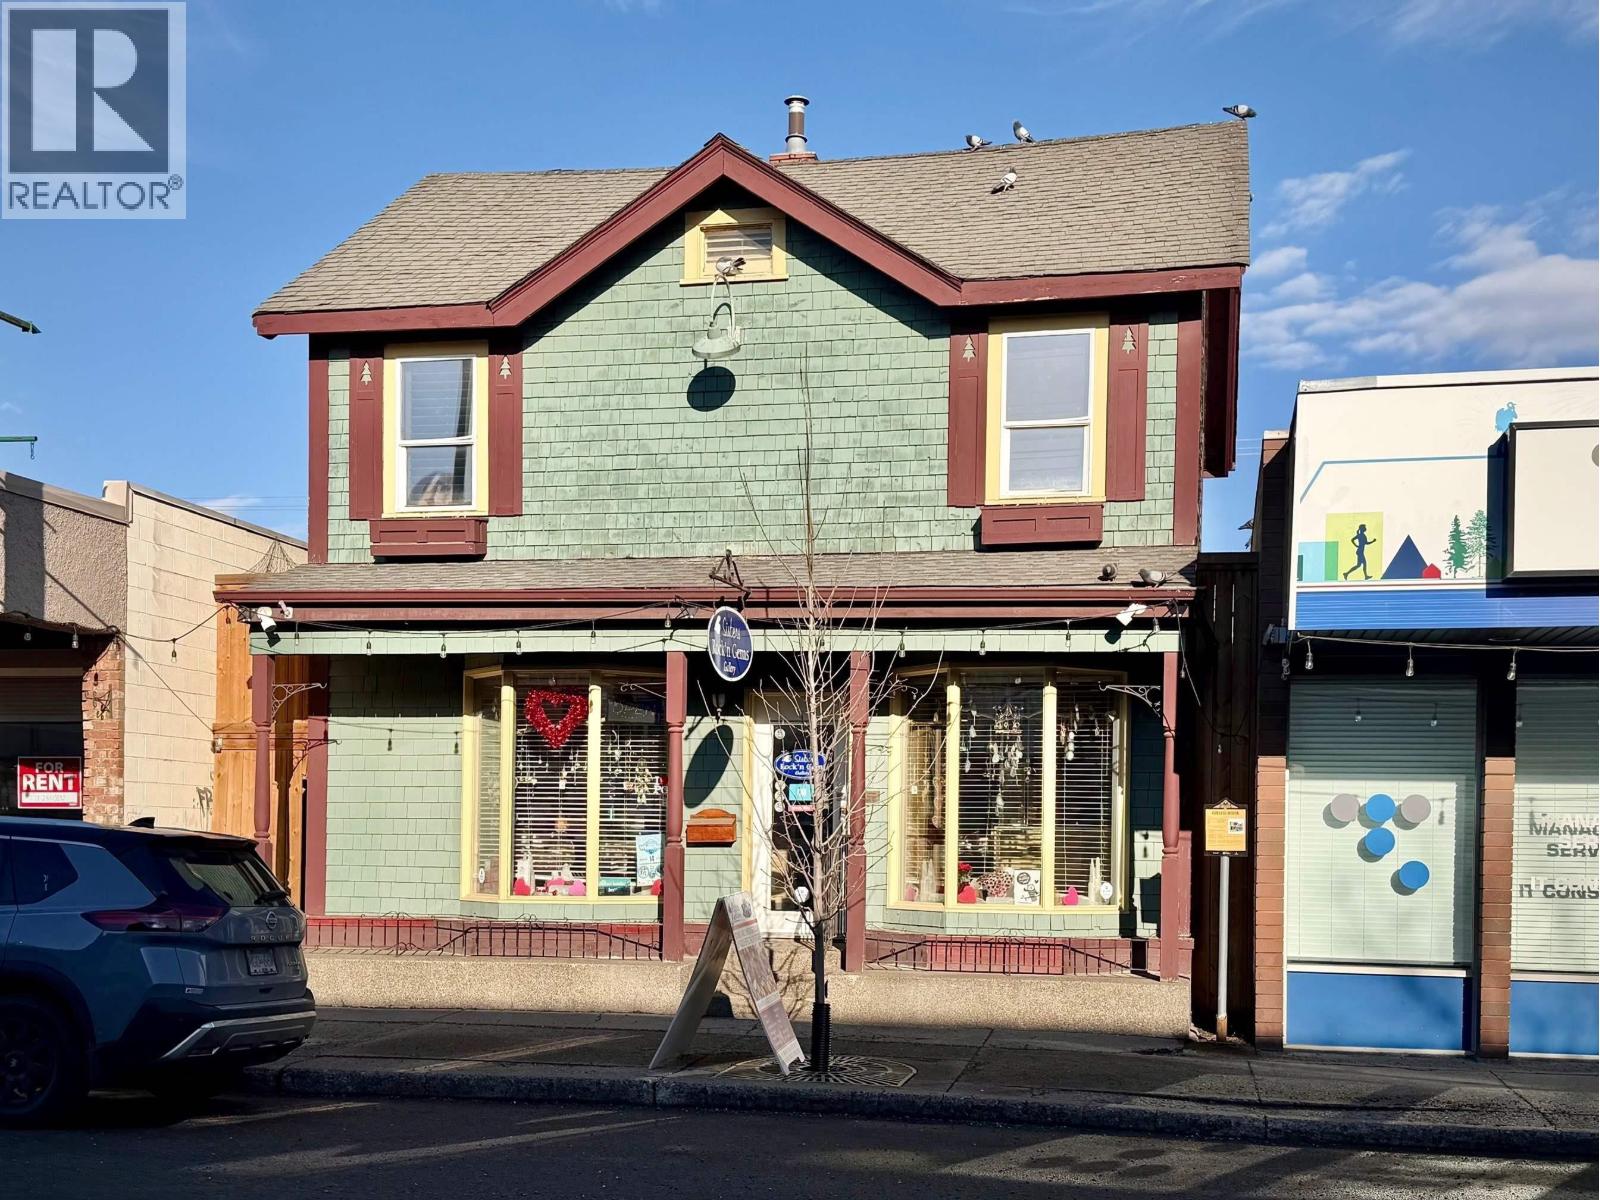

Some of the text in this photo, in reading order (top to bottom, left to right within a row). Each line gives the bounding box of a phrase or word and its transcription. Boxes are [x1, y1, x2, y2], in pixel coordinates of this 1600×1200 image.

[732, 643, 749, 661] Gems
[35, 762, 64, 774] FOR
[22, 773, 77, 791] RENT
